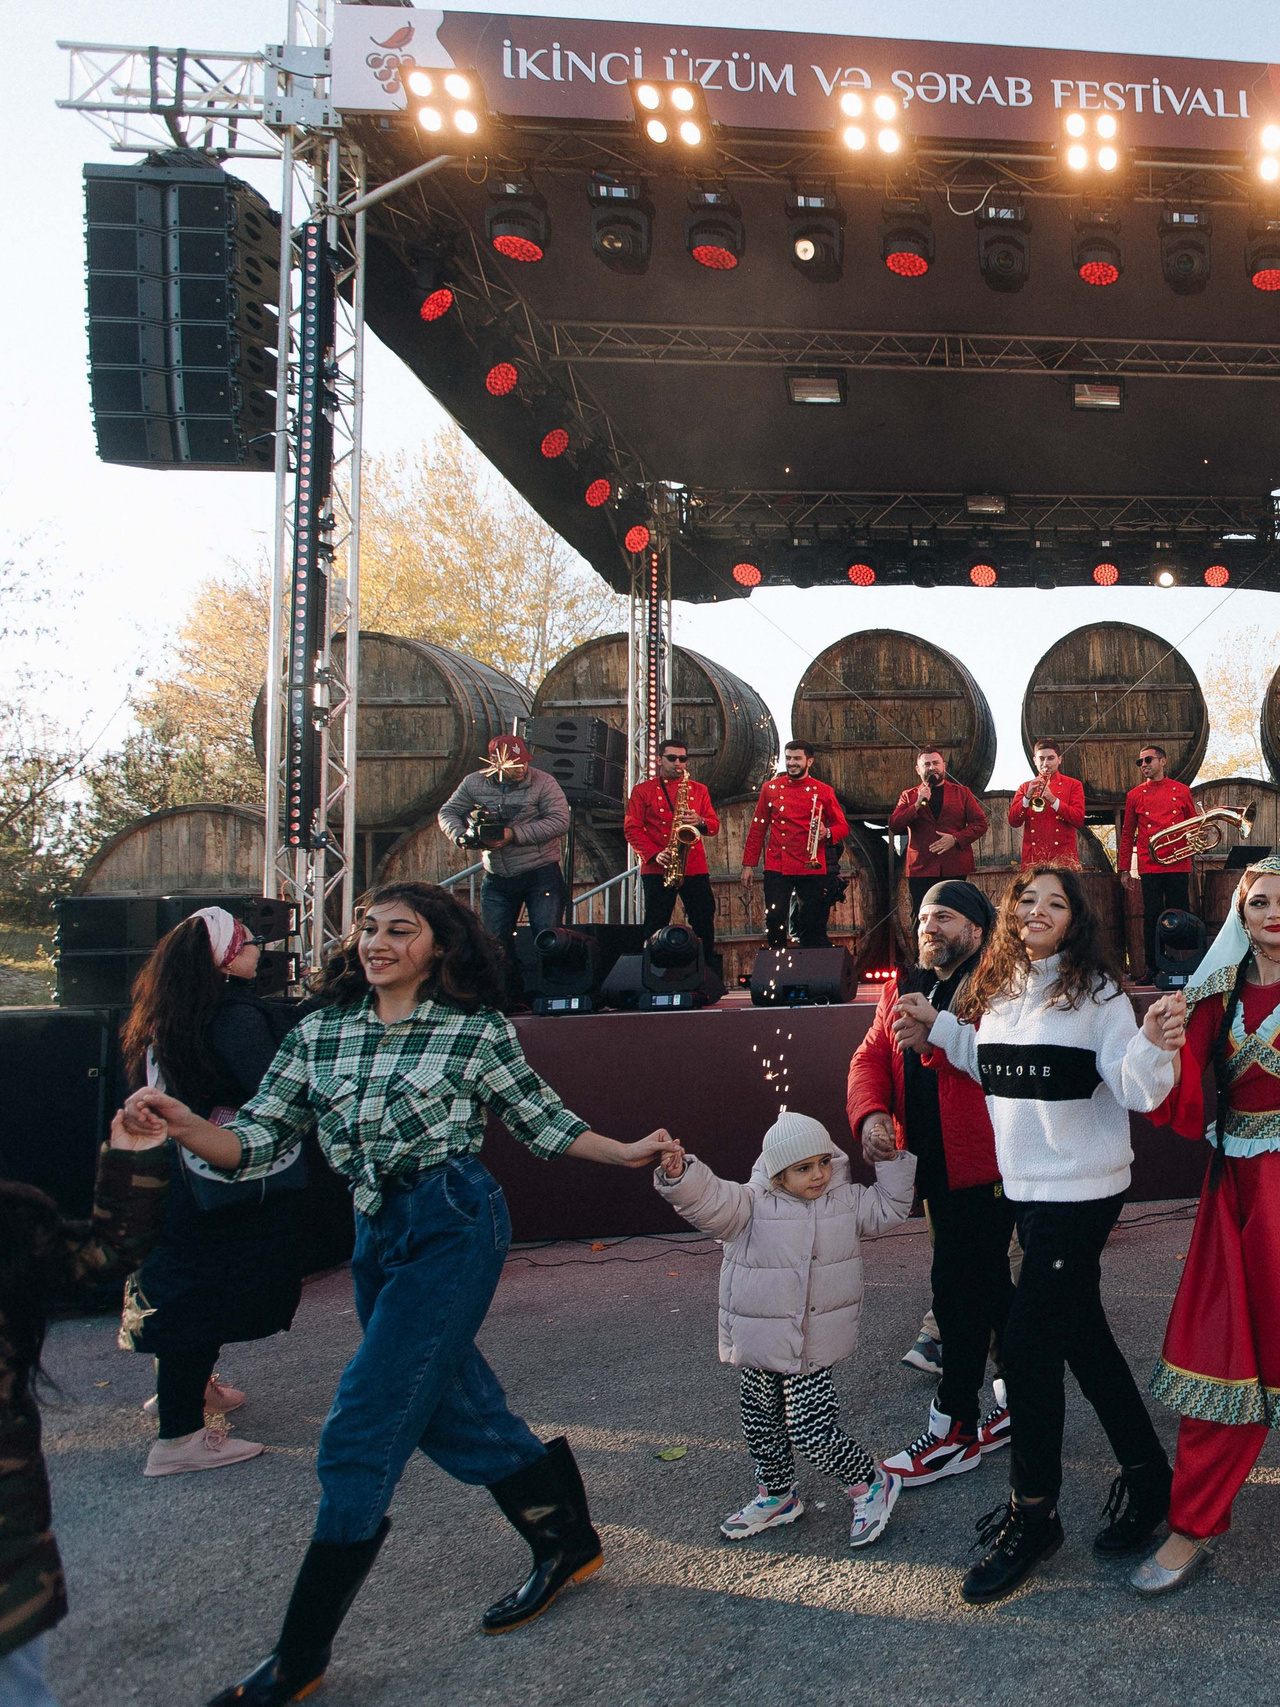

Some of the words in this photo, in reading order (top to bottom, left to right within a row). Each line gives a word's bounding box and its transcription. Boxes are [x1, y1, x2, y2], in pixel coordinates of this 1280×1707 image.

[502, 39, 643, 85] İKİNCİ
[662, 48, 798, 97] ÜZÜM
[810, 64, 872, 97] VƏ
[891, 70, 1034, 109] ŞƏRAB
[1050, 77, 1251, 119] FESTİVALI
